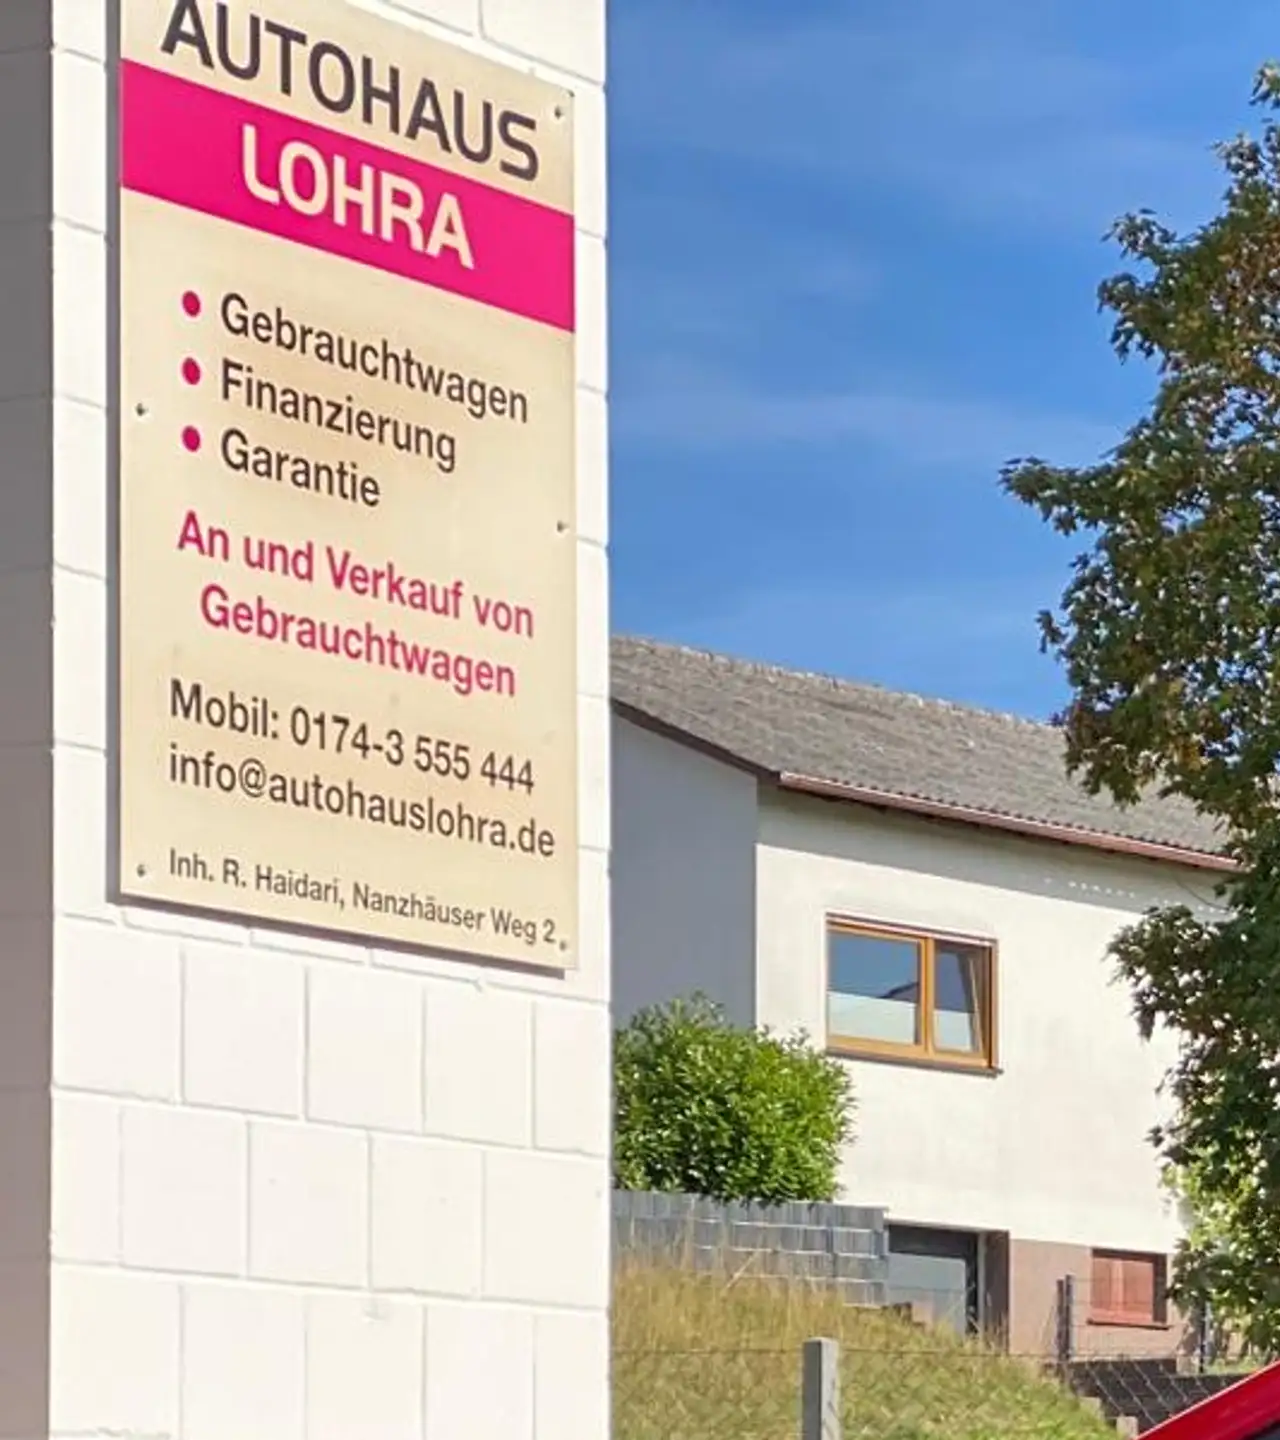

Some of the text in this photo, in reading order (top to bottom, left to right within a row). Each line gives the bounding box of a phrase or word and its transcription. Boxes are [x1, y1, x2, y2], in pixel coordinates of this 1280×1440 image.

[160, 0, 539, 182] AUTOHAUS
[241, 123, 475, 270] LOHRA
[220, 292, 529, 424] Gebrauchtwagen
[221, 357, 457, 474] Finanzierung
[220, 428, 380, 507] Garantie
[177, 510, 535, 638] An und Verkauf von
[200, 583, 516, 697] Gebrauchtwagen
[170, 678, 535, 795] Mobil: 0174-3 555 444
[169, 743, 556, 857] info@autohauslohra.de
[169, 847, 557, 945] Inh. R. Haidari, Nanzhäuser Weg 2
